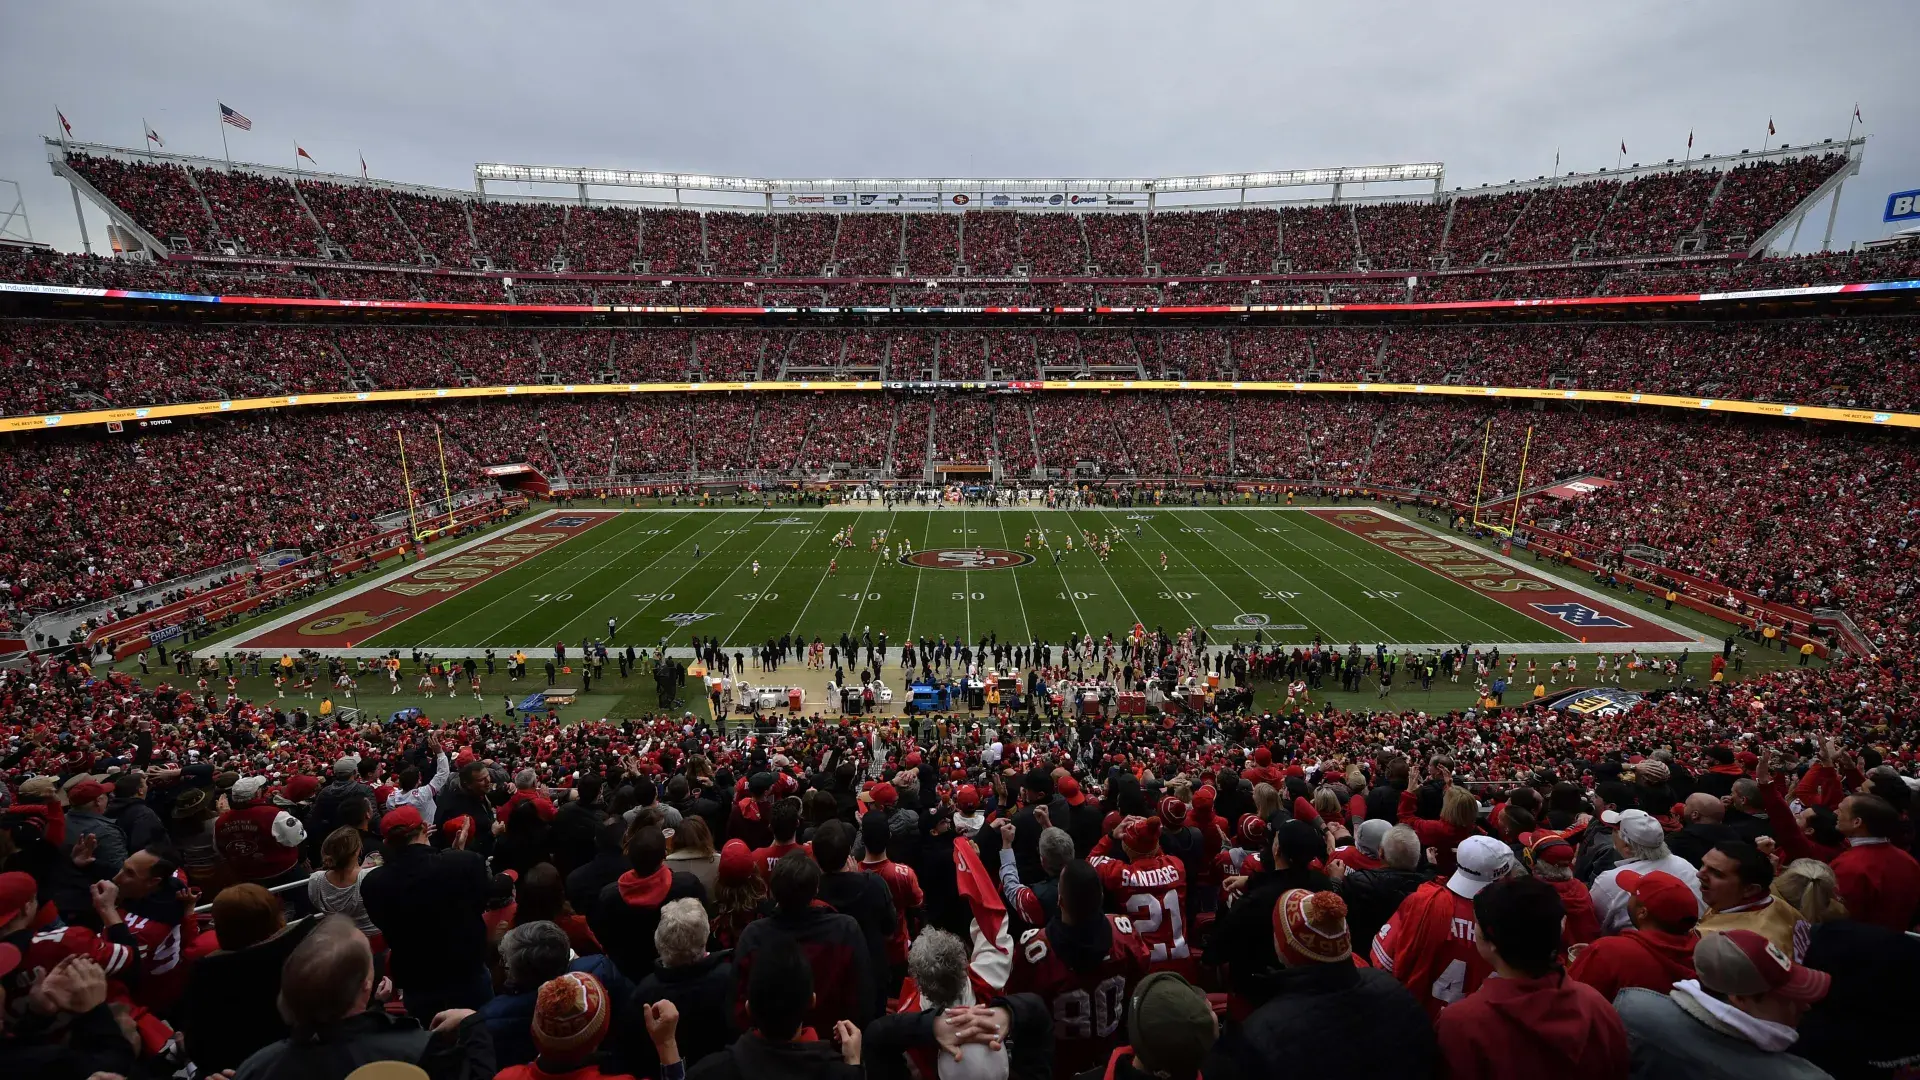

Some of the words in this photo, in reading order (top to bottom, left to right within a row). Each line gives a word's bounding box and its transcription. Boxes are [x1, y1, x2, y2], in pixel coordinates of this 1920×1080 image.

[5, 284, 40, 292] Industrial
[383, 533, 569, 597] 49ERS
[1362, 530, 1558, 593] 49ERS
[534, 593, 574, 602] 10
[637, 593, 676, 602] 20
[742, 592, 779, 601] 30
[847, 592, 881, 601] 40
[951, 592, 986, 601] 50
[1055, 591, 1089, 600] 40
[1157, 591, 1192, 600] 30
[1258, 590, 1296, 599] 20
[1361, 590, 1399, 599] 10
[1121, 866, 1180, 887] SANDERS
[1126, 889, 1190, 961] 21
[1432, 959, 1467, 1003] 4
